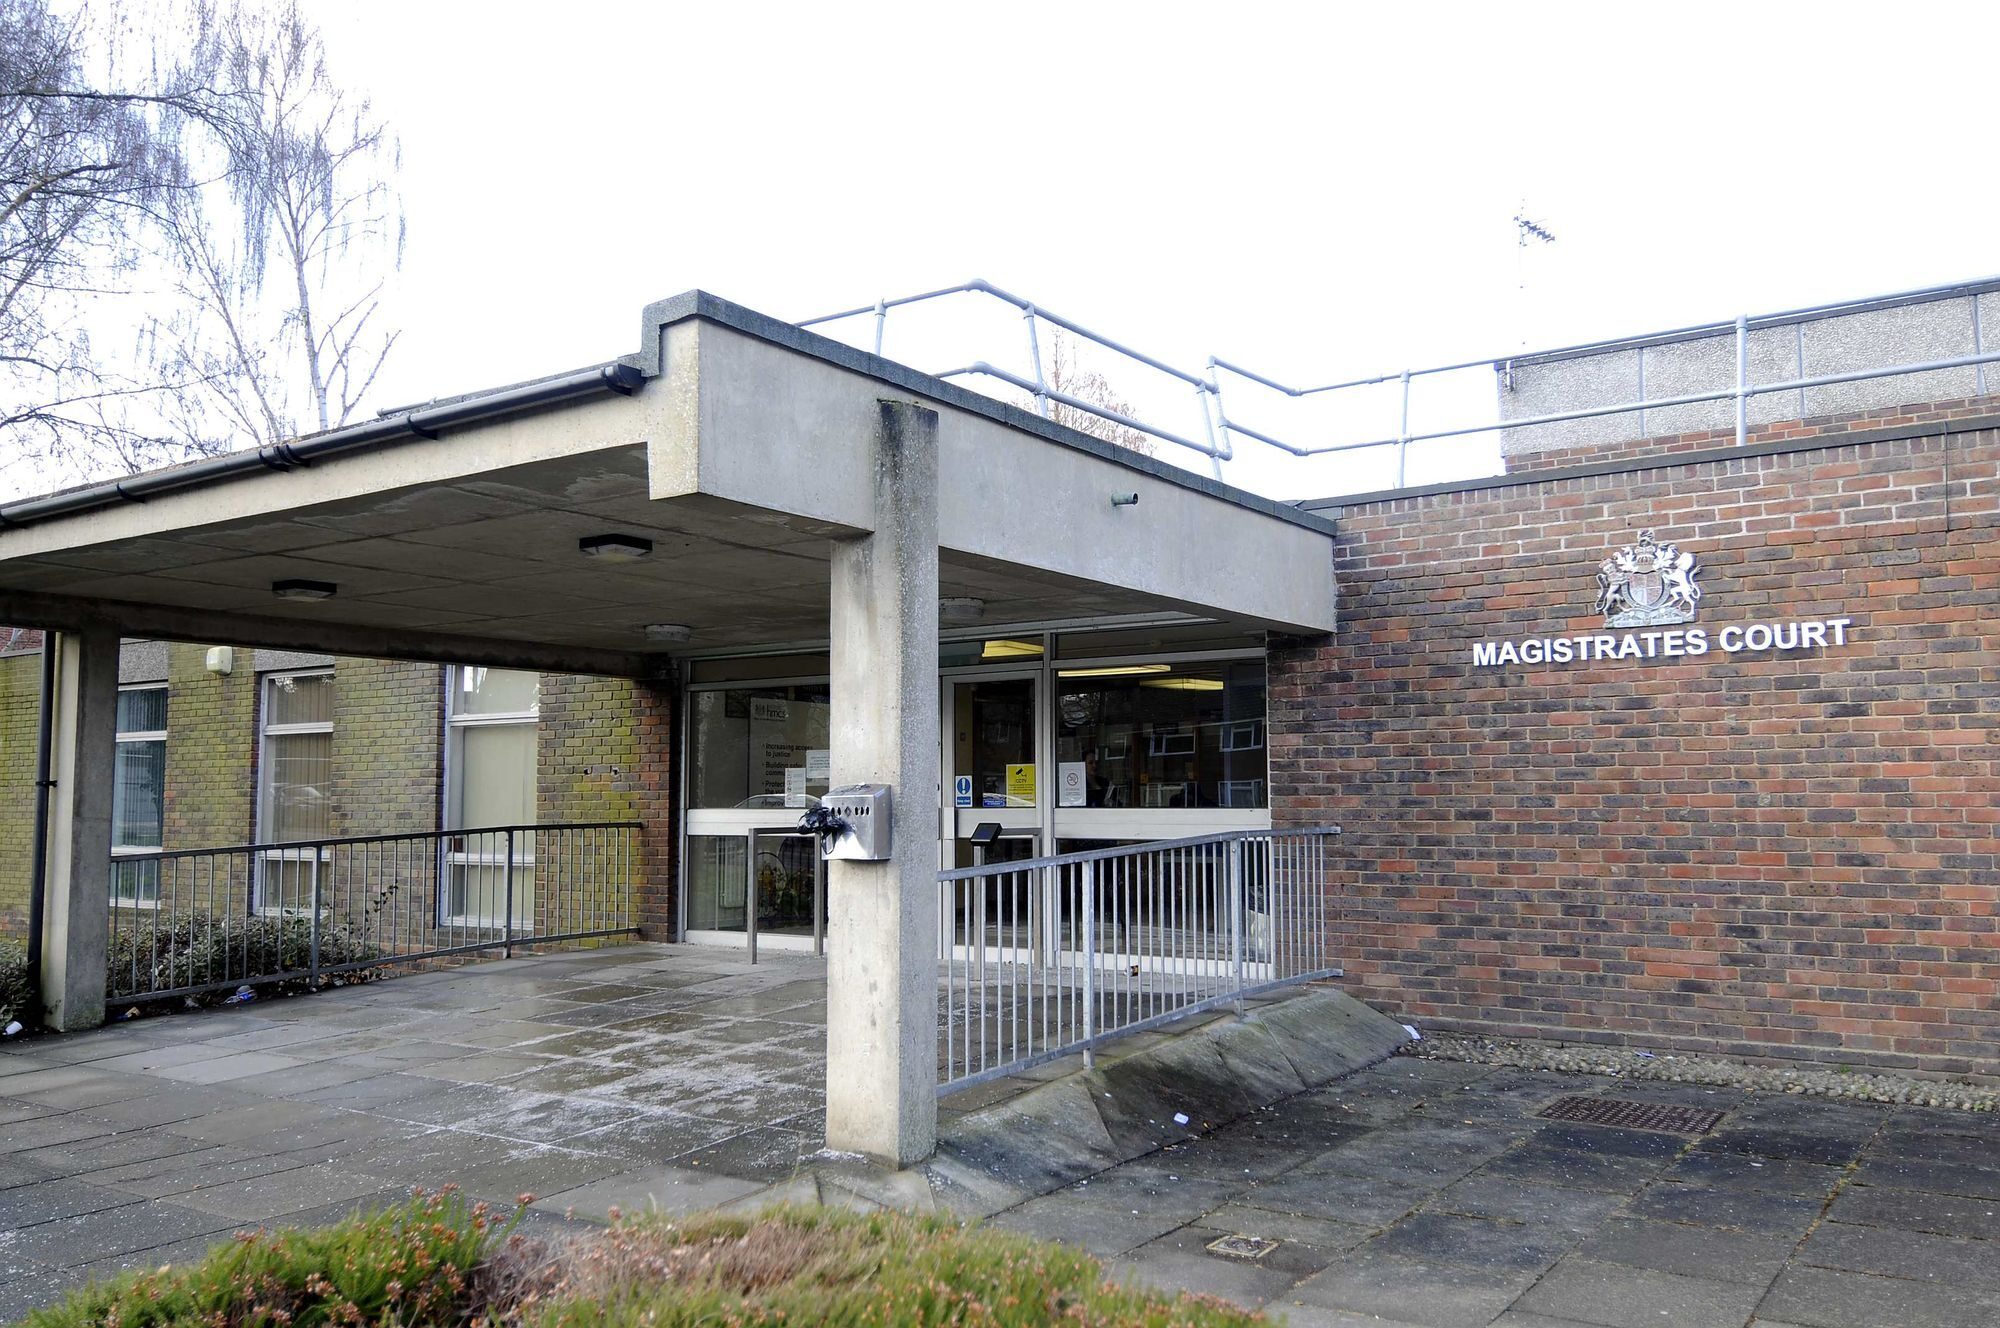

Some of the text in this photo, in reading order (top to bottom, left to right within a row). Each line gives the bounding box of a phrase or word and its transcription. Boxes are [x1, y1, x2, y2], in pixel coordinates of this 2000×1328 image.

[1473, 618, 1851, 667] MAGISTRATES COURT
[766, 703, 786, 719] hmcs
[765, 742, 795, 752] Increasing
[772, 750, 791, 758] justice
